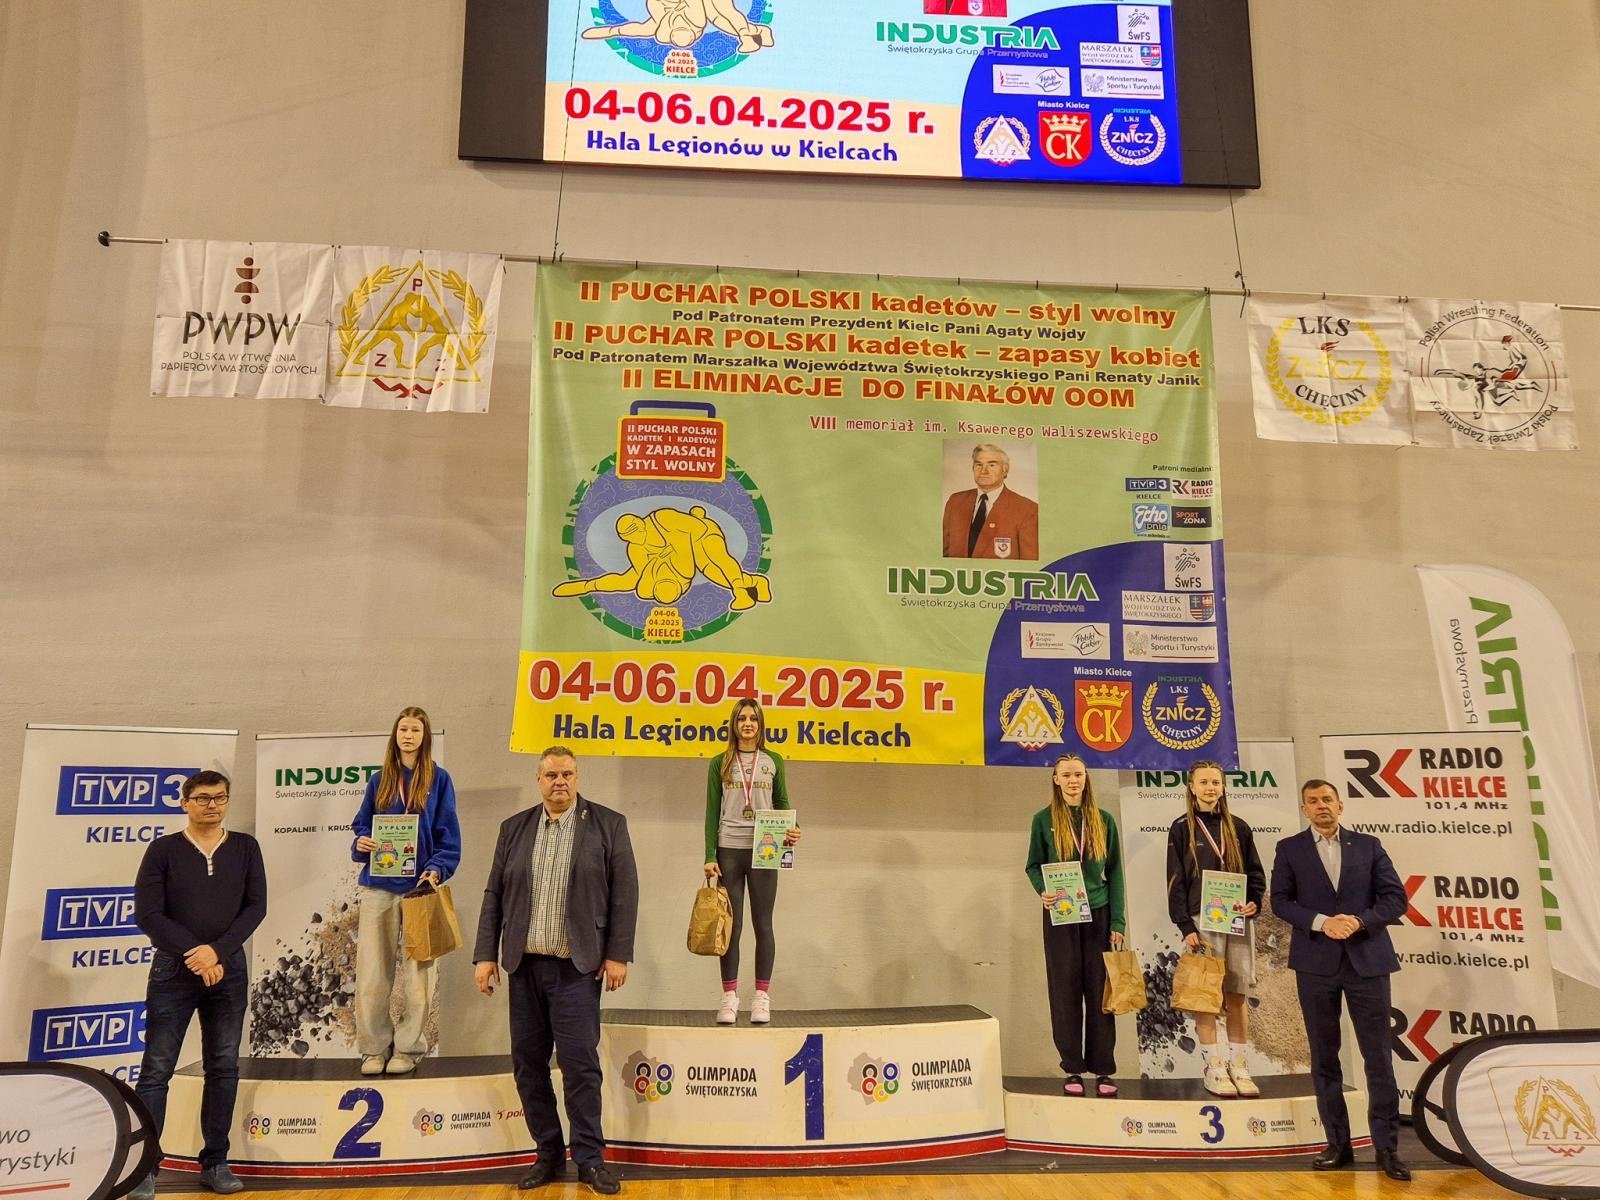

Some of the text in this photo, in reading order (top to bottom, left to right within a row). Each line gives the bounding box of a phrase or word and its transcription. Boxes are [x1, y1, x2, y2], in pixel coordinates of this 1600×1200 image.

[876, 21, 1061, 50] INDUSTRIA
[1128, 30, 1150, 40] ŚwFS
[888, 44, 1049, 59] Świętokrzyska Grupa Przemysłowa
[1081, 44, 1133, 53] MARSZAŁEK
[666, 65, 696, 75] KIELCE
[1133, 83, 1161, 91] Turystyki
[565, 87, 934, 134] 04-06.04.2025 r.
[1065, 101, 1090, 109] Kielce
[587, 130, 898, 161] Hala Legionów w Kielcach
[1112, 130, 1154, 144] ZNICZ
[1046, 134, 1083, 161] CK
[581, 282, 1176, 329] II PUCHAR POLSKI kadetów styl wolny
[182, 311, 301, 346] PWPW
[673, 310, 1086, 341] Pod Patronatem Prezydent Kielc Pani Agaty Wojdy
[1297, 316, 1350, 336] LKS
[1419, 306, 1550, 351] Polish Wrestlng Federation
[554, 322, 1201, 368] II PUCHAR POLSKI kadetek zapasy kobiet
[182, 351, 225, 362] POLSKA
[554, 348, 1200, 386] Pod Patronatem Marszałka Województwa Świętokrzyskiego Pani Renaty Janik
[623, 369, 1135, 407] II ELIMINACJE DO FINAŁÓW OOM
[1295, 383, 1368, 410] CHĘCINY
[1532, 404, 1559, 432] Polski
[638, 425, 678, 433] PUCHAR
[682, 426, 716, 435] POLSKI
[810, 416, 1159, 444] VIII memoriał im. Ksawerego Waliszewskiego
[678, 436, 716, 444] KADETÓW
[627, 445, 715, 457] W ZAPASACH
[626, 459, 715, 472] STYL WOLNY
[1159, 480, 1166, 489] 3
[887, 567, 1099, 601] INDUSTRIA
[1175, 576, 1201, 588] ŚwFS
[900, 597, 1085, 613] Świętokrzyska Grupa Przemysłowa
[1125, 594, 1181, 604] MARSZAŁEK
[647, 628, 680, 638] KIELCE
[1151, 644, 1174, 652] Sportu
[1074, 666, 1132, 677] Miasto Kielce
[529, 659, 954, 711] 04-06.04.2025 r.
[1170, 685, 1189, 694] LKS
[1156, 703, 1206, 721] ZNICZ
[553, 713, 911, 747] Hala Legionó w Kielcach
[1082, 708, 1123, 743] CK
[1161, 724, 1203, 739] CHĘCINY
[1419, 747, 1503, 769] RADIO
[1344, 749, 1418, 798] RK
[76, 774, 188, 807] TVP 3
[276, 789, 365, 799] Świętokrzyska Grupa
[1422, 776, 1508, 798] KIELCE
[1426, 801, 1468, 810] 101,4
[87, 826, 164, 843] KIELCE
[275, 826, 317, 834] KOPALNIE
[1352, 821, 1512, 836] www.radio.kielce.pl
[1434, 876, 1519, 899] RADIO
[61, 897, 134, 928] TVP
[1437, 906, 1524, 930] KIELCE
[1440, 932, 1525, 943] 101,4 MHz
[72, 947, 151, 968] KIELCE
[48, 1014, 129, 1050] TVP
[1450, 1011, 1536, 1035] RADIO
[688, 1066, 756, 1082] OLIMPIADA
[912, 1058, 971, 1077] OLIMPIADA
[686, 1083, 758, 1098] ŚWIĘTOKRZYSKA
[784, 1033, 824, 1140] 1
[911, 1076, 972, 1092] ŚWIĘTOKRZYSKA
[278, 1118, 316, 1126] OLIMPIADA
[333, 1088, 384, 1159] 2
[452, 1111, 491, 1121] OLIMPIADA
[1199, 1105, 1224, 1144] 3
